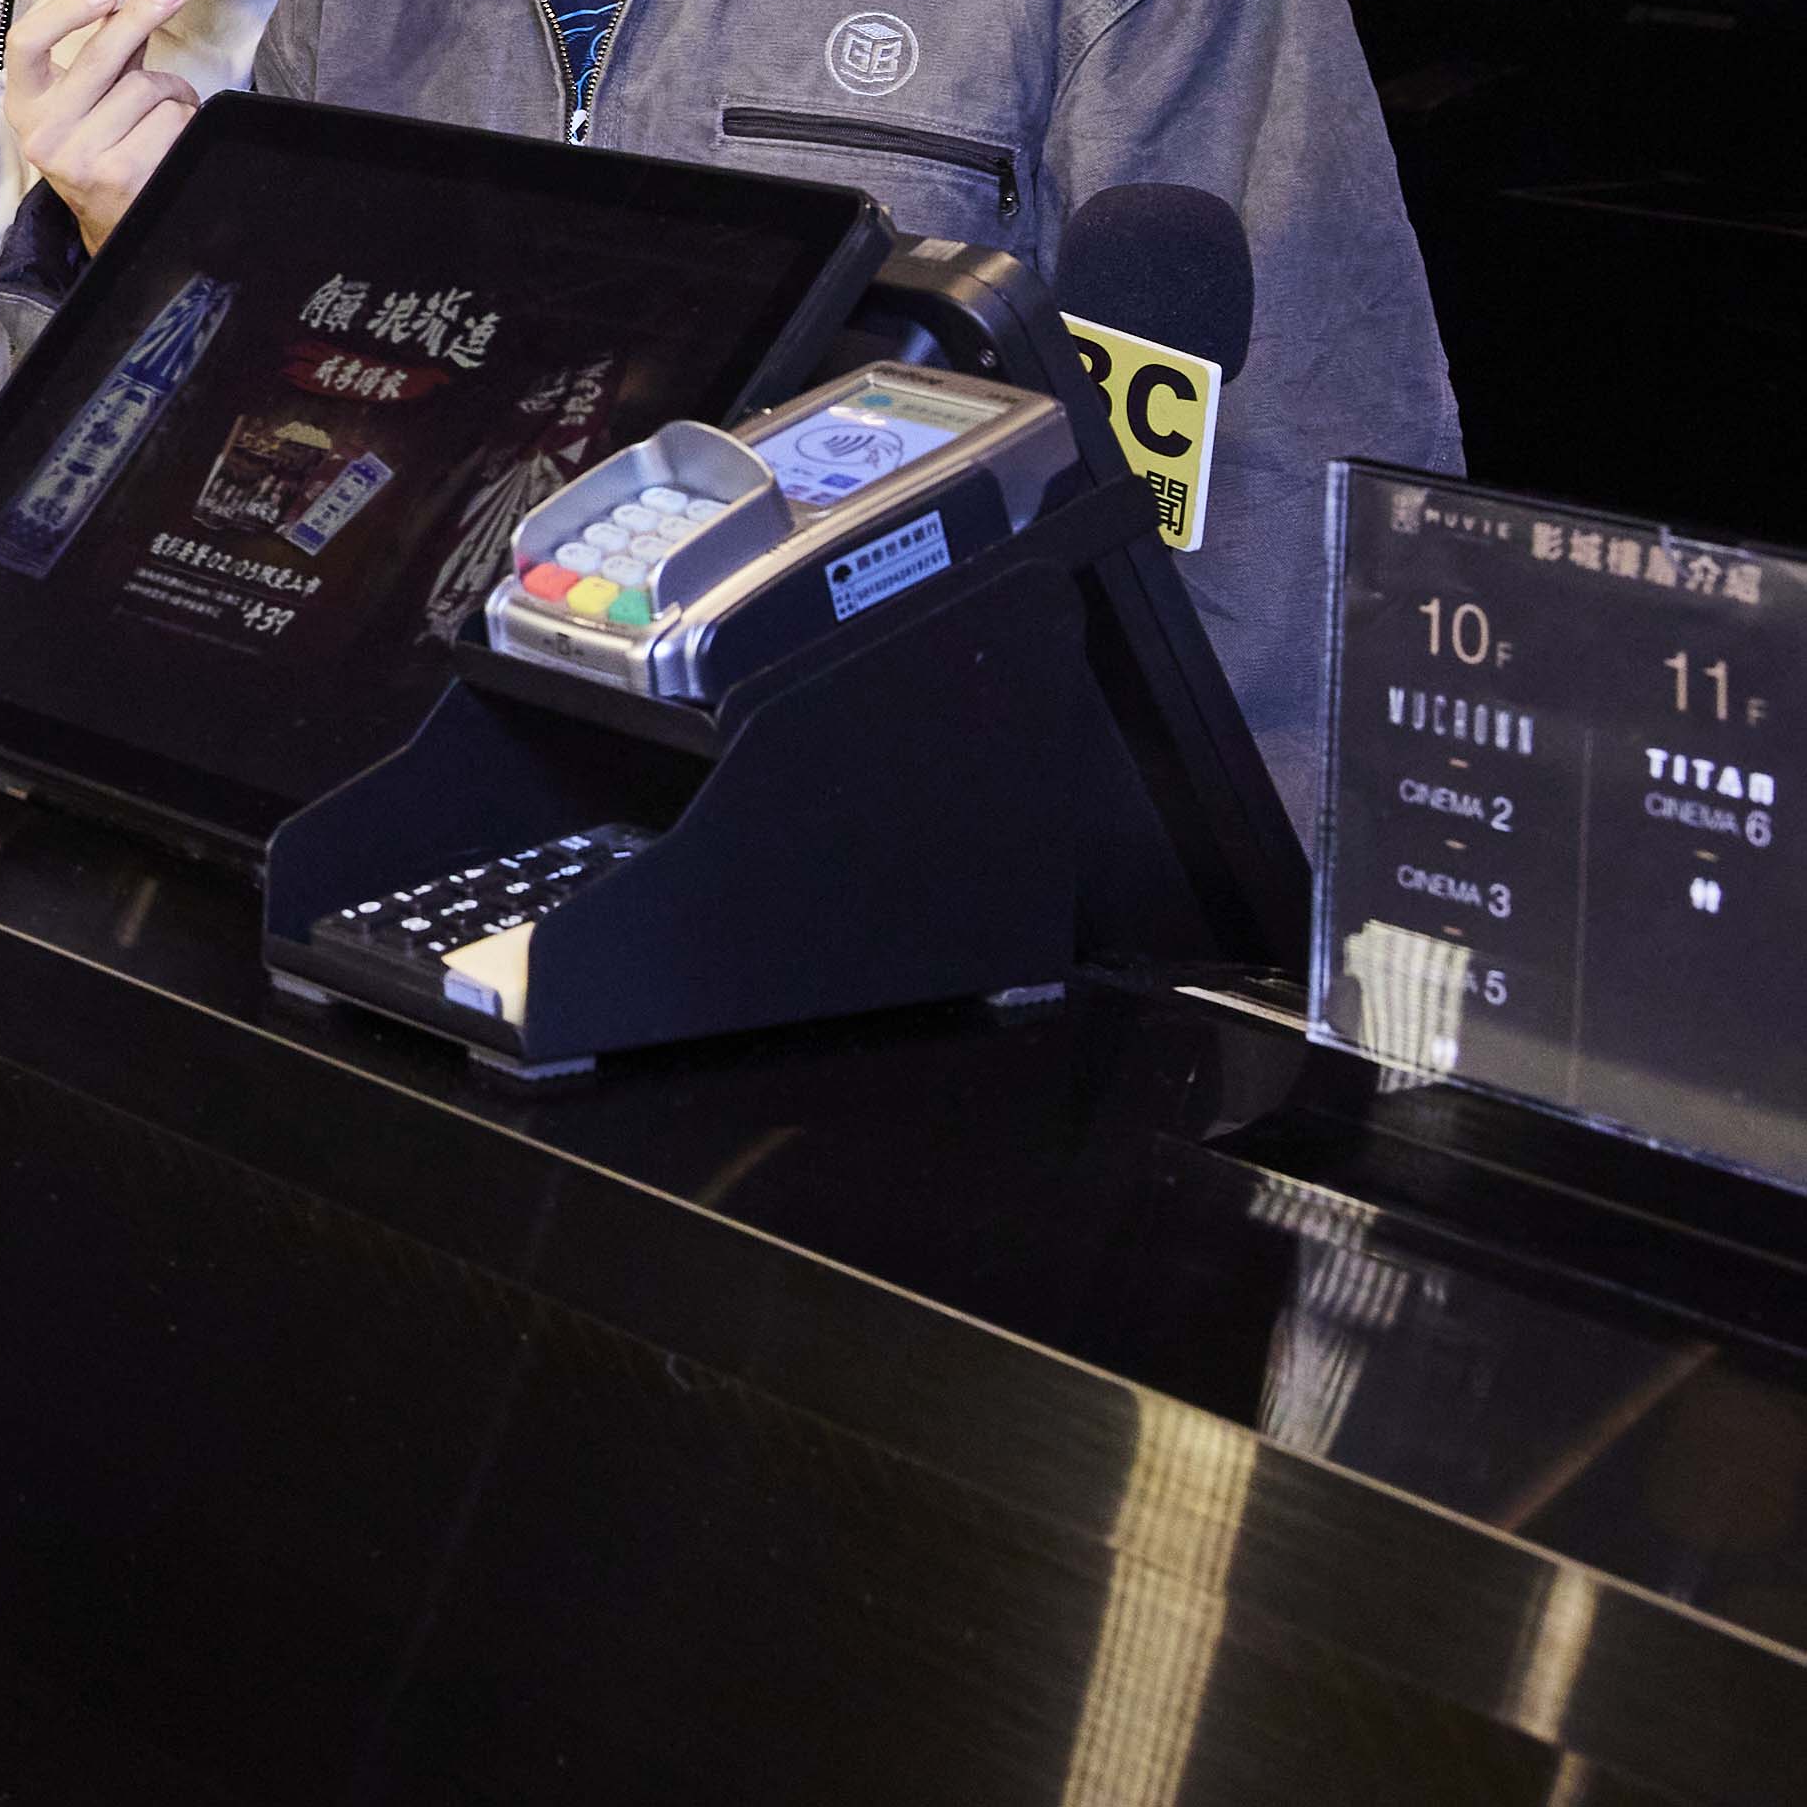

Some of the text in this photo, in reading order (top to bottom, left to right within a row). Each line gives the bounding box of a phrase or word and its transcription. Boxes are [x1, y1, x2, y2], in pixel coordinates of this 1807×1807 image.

[1644, 747, 1775, 807] TITAN
[1398, 778, 1514, 833] CINEMA 2
[1643, 792, 1774, 848] CINEMA 6
[1397, 863, 1513, 918] CINEMA 3
[1484, 969, 1508, 1006] 5
